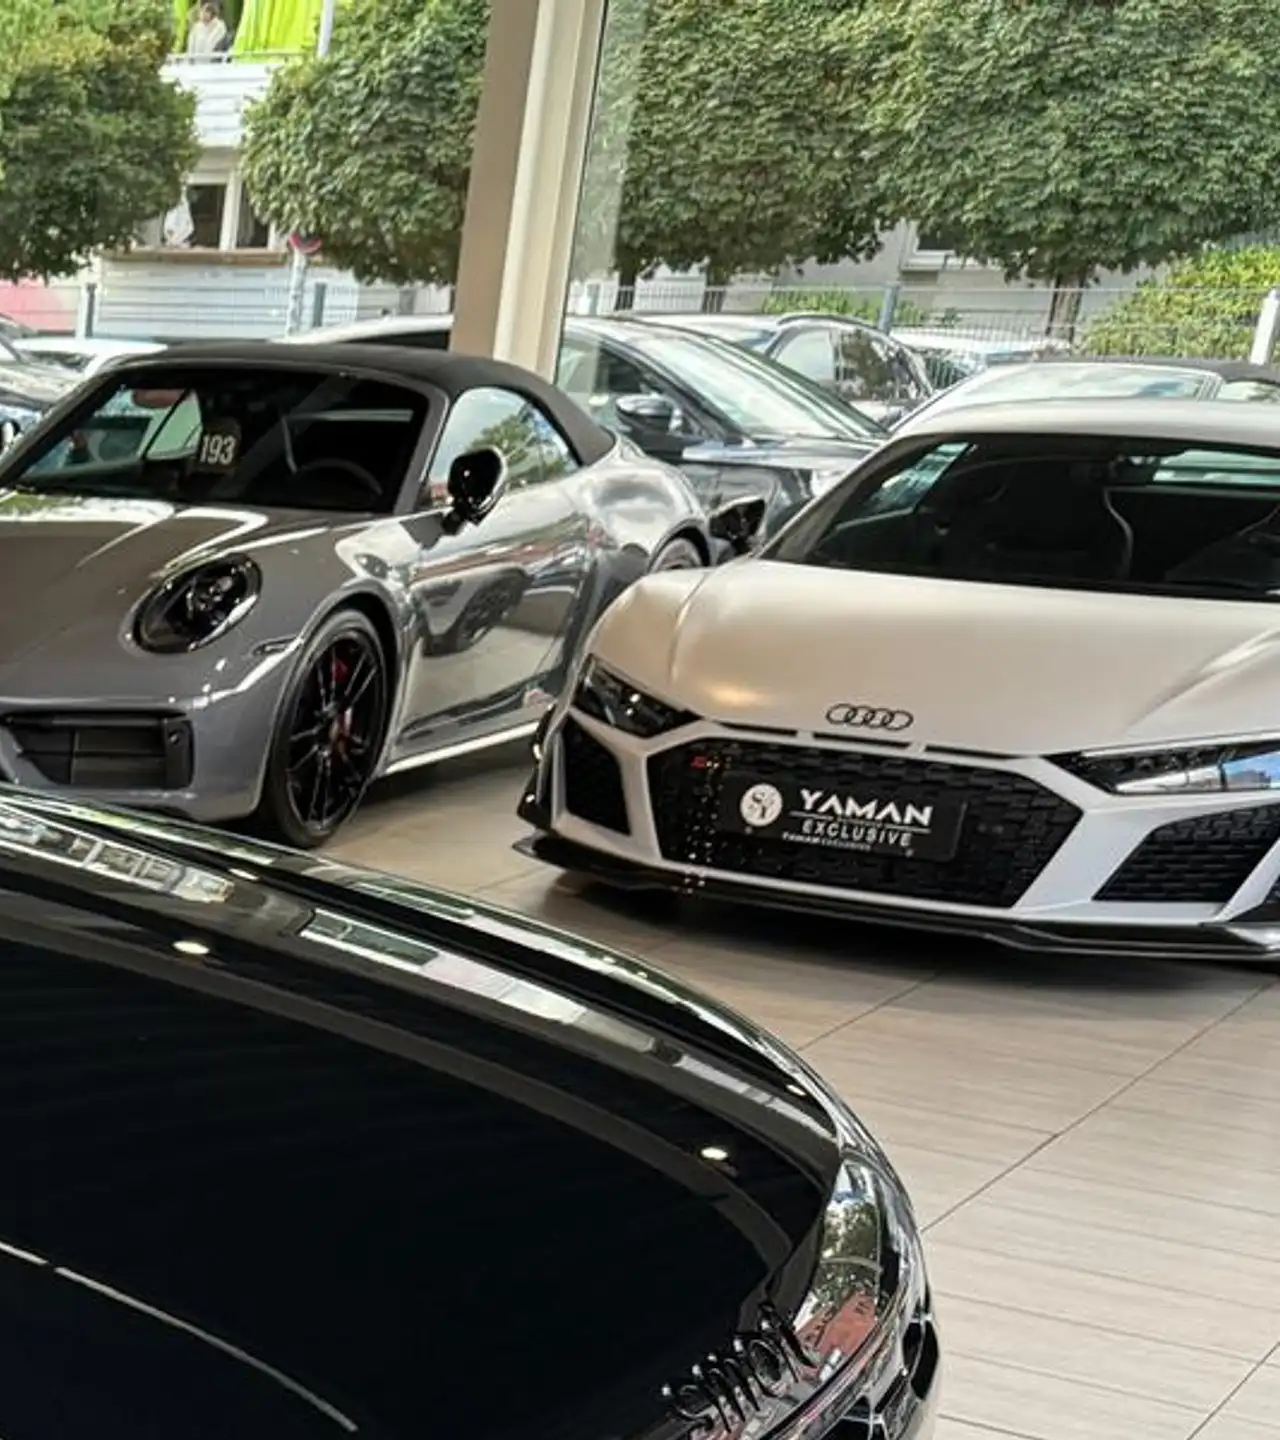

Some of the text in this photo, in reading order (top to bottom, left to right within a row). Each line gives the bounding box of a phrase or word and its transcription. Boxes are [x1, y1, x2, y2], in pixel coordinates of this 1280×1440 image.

[200, 434, 236, 465] 193
[800, 788, 933, 826] YAMAN
[802, 819, 912, 846] EXCLUSIVE
